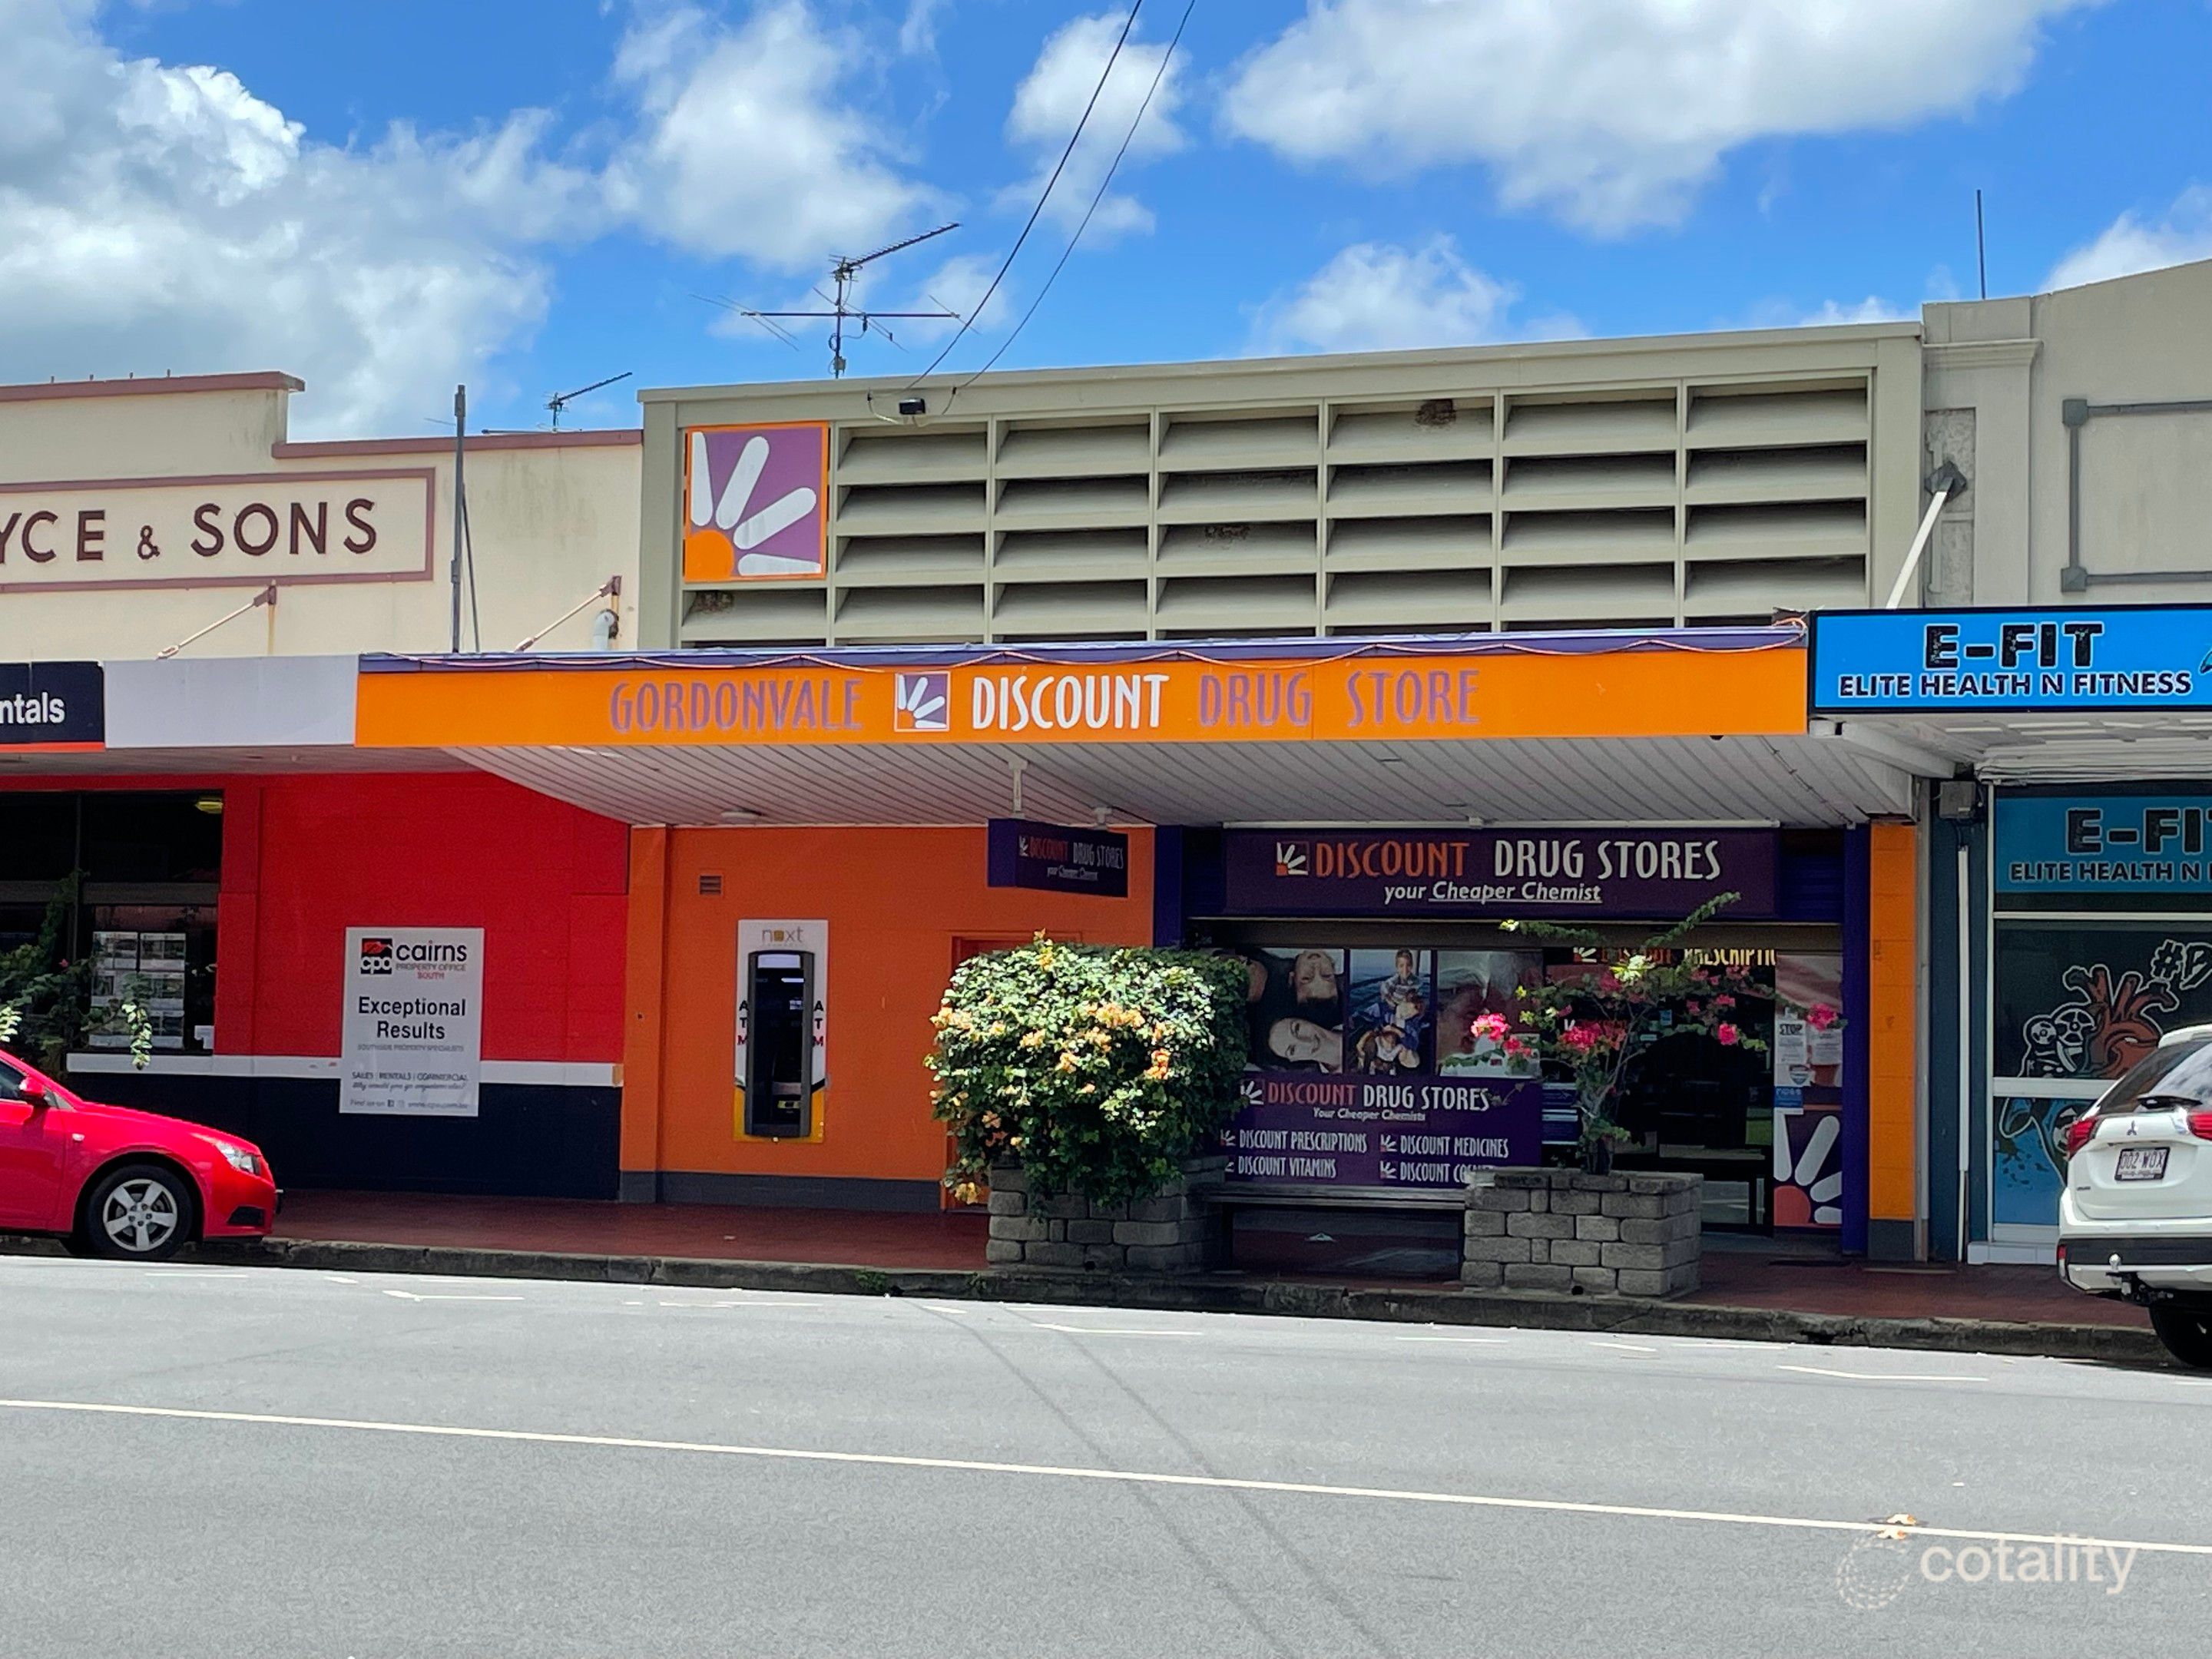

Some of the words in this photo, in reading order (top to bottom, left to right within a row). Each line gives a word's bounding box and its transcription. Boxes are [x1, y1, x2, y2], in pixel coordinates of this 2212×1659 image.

[137, 525, 161, 559] &
[191, 498, 377, 557] SONS
[1925, 621, 2104, 670] E-FIT
[1839, 674, 1912, 697] ELITE
[1920, 673, 2032, 697] HEALTH
[2041, 672, 2064, 695] N
[2075, 671, 2192, 696] FITNESS
[0, 691, 65, 724] ntals
[610, 679, 863, 733] GORDONVALE
[972, 674, 1170, 731] DISCOUNT
[1198, 671, 1313, 728] DRUG
[1347, 669, 1481, 728] STORE
[2066, 808, 2212, 854] E-FI
[1316, 841, 1470, 879] DISCOUNT
[1495, 839, 1584, 879] DRUG
[1598, 839, 1722, 880] STORES
[2010, 861, 2072, 882] ELITE
[2078, 860, 2174, 882] HEALTH
[2181, 861, 2201, 881] N
[1384, 885, 1426, 905] your
[1432, 882, 1518, 905] Cheaper
[1522, 882, 1602, 902] Chemist
[396, 940, 467, 962] cairns
[359, 996, 466, 1018] Exceptional
[377, 1021, 445, 1039] Results
[813, 1000, 824, 1046] ATM
[1268, 1082, 1358, 1105] DISCOUNT
[1363, 1084, 1415, 1108] DRUG
[1421, 1086, 1490, 1111] STORES
[1313, 1107, 1335, 1118] Your
[1239, 1129, 1289, 1150] DISCOUNT
[1290, 1131, 1368, 1154] PRESCRIPTIONS
[1400, 1135, 1451, 1156] DISCOUNT
[1454, 1137, 1508, 1158] MEDICINES
[1238, 1155, 1286, 1176] DISCOUNT
[1289, 1157, 1336, 1178] VITAMINS
[1399, 1161, 1451, 1183] DISCOUNT
